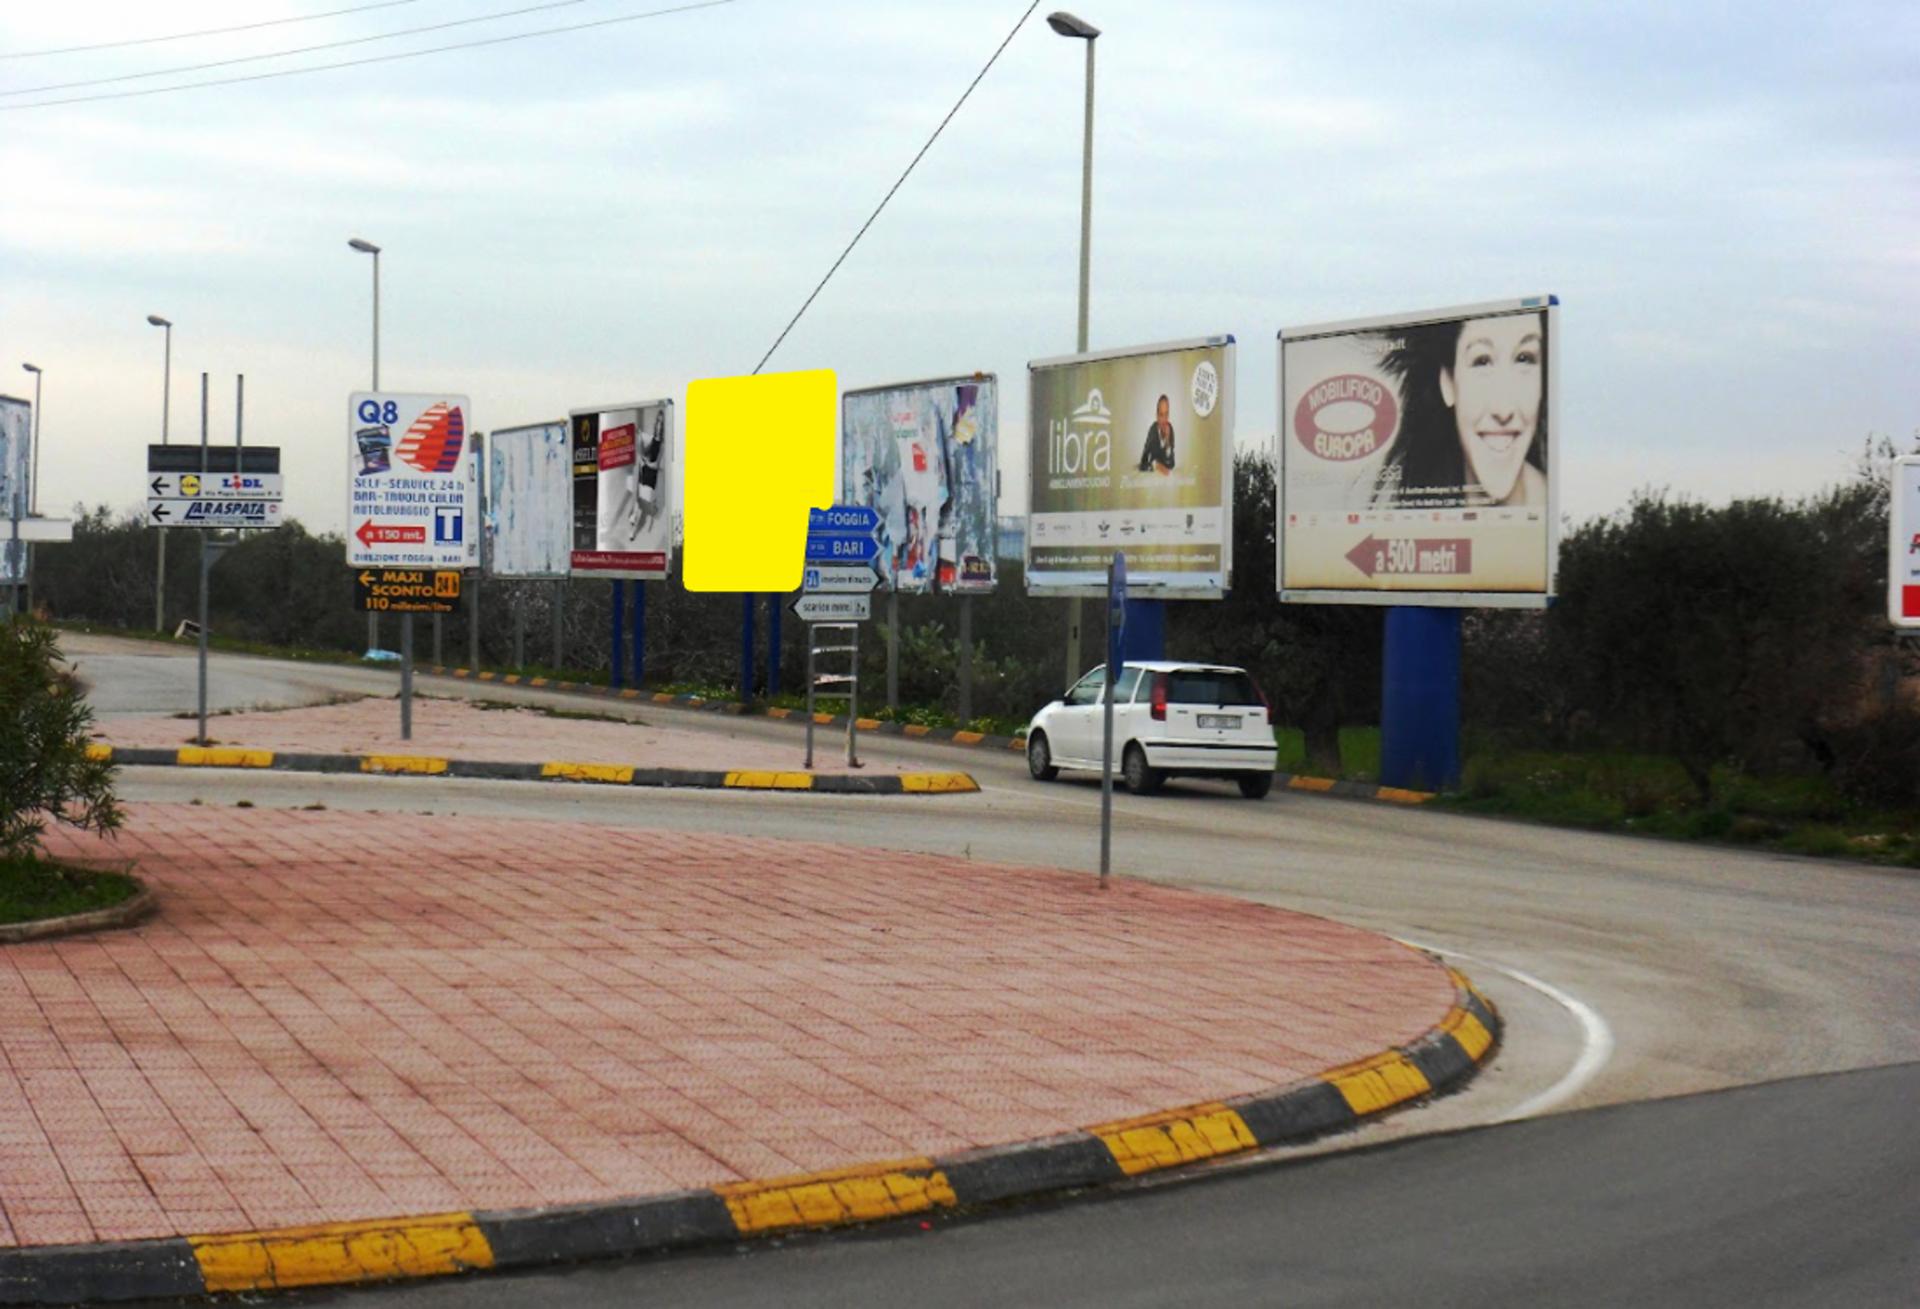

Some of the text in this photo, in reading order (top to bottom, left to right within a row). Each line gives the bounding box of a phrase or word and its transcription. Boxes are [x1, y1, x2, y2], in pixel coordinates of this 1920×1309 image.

[358, 400, 398, 424] Q8
[1049, 417, 1111, 474] libra
[1314, 428, 1376, 459] EUROPA
[827, 512, 870, 526] FOGGIA
[378, 529, 399, 539] 150
[833, 541, 864, 555] BARI
[354, 553, 399, 562] DIREZIONE
[402, 553, 433, 562] FOGGIA
[442, 554, 461, 562] BARI
[1375, 539, 1456, 572] a 500 metri
[383, 570, 423, 583] MAXI
[371, 584, 435, 597] SCONTO
[366, 597, 389, 610] 110
